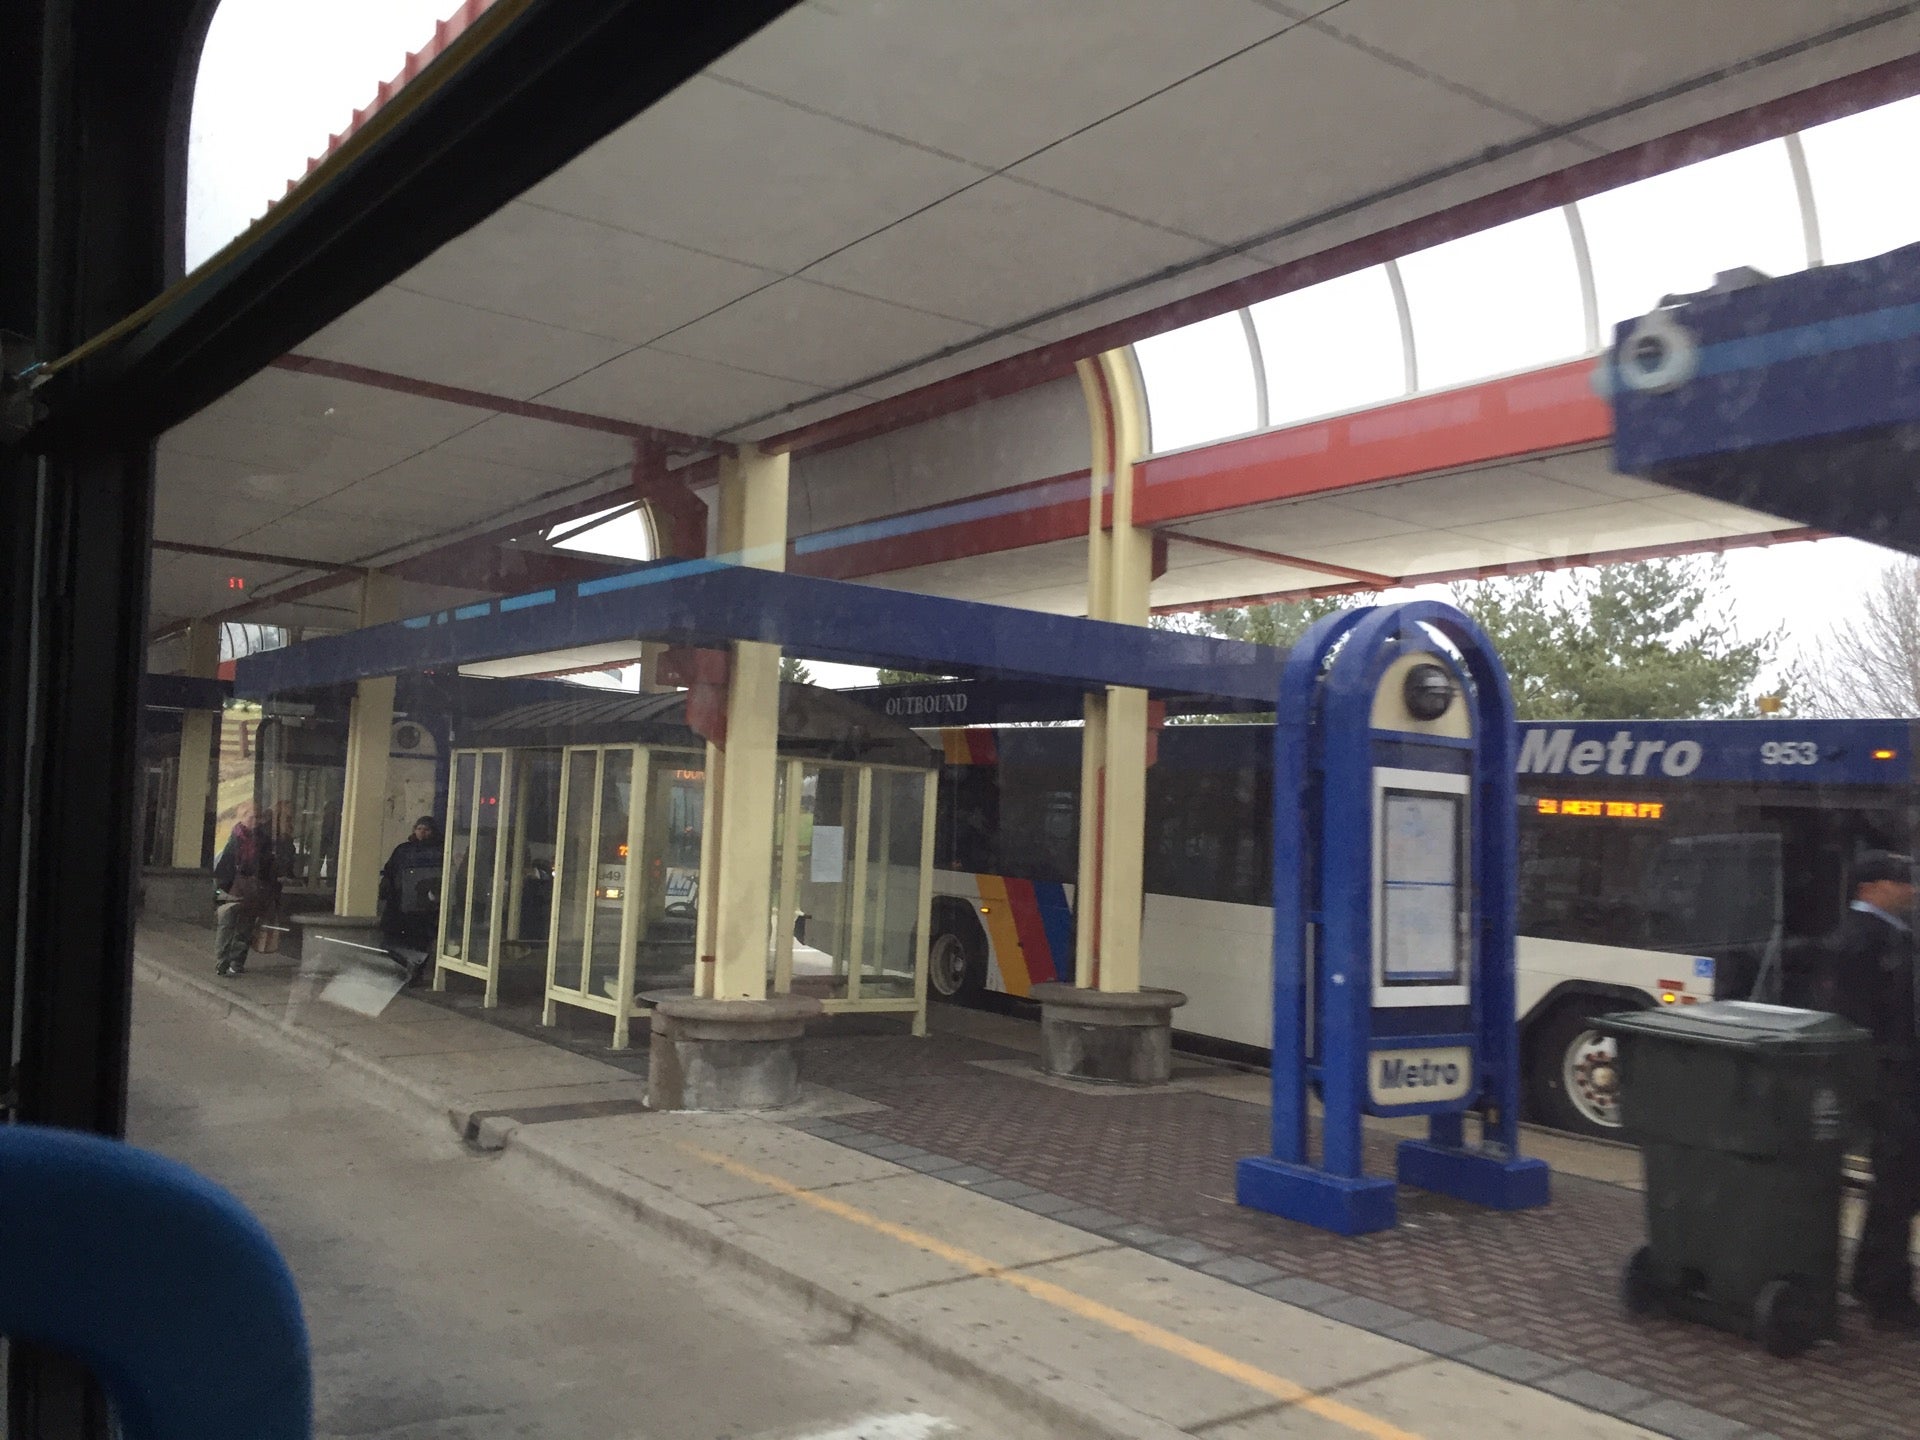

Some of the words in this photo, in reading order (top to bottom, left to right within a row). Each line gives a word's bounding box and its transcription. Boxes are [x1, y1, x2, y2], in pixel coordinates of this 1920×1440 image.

[885, 693, 968, 716] OUTBOUND
[1516, 728, 1702, 777] Metro
[1760, 741, 1819, 765] 953
[1379, 1058, 1460, 1089] Metro
